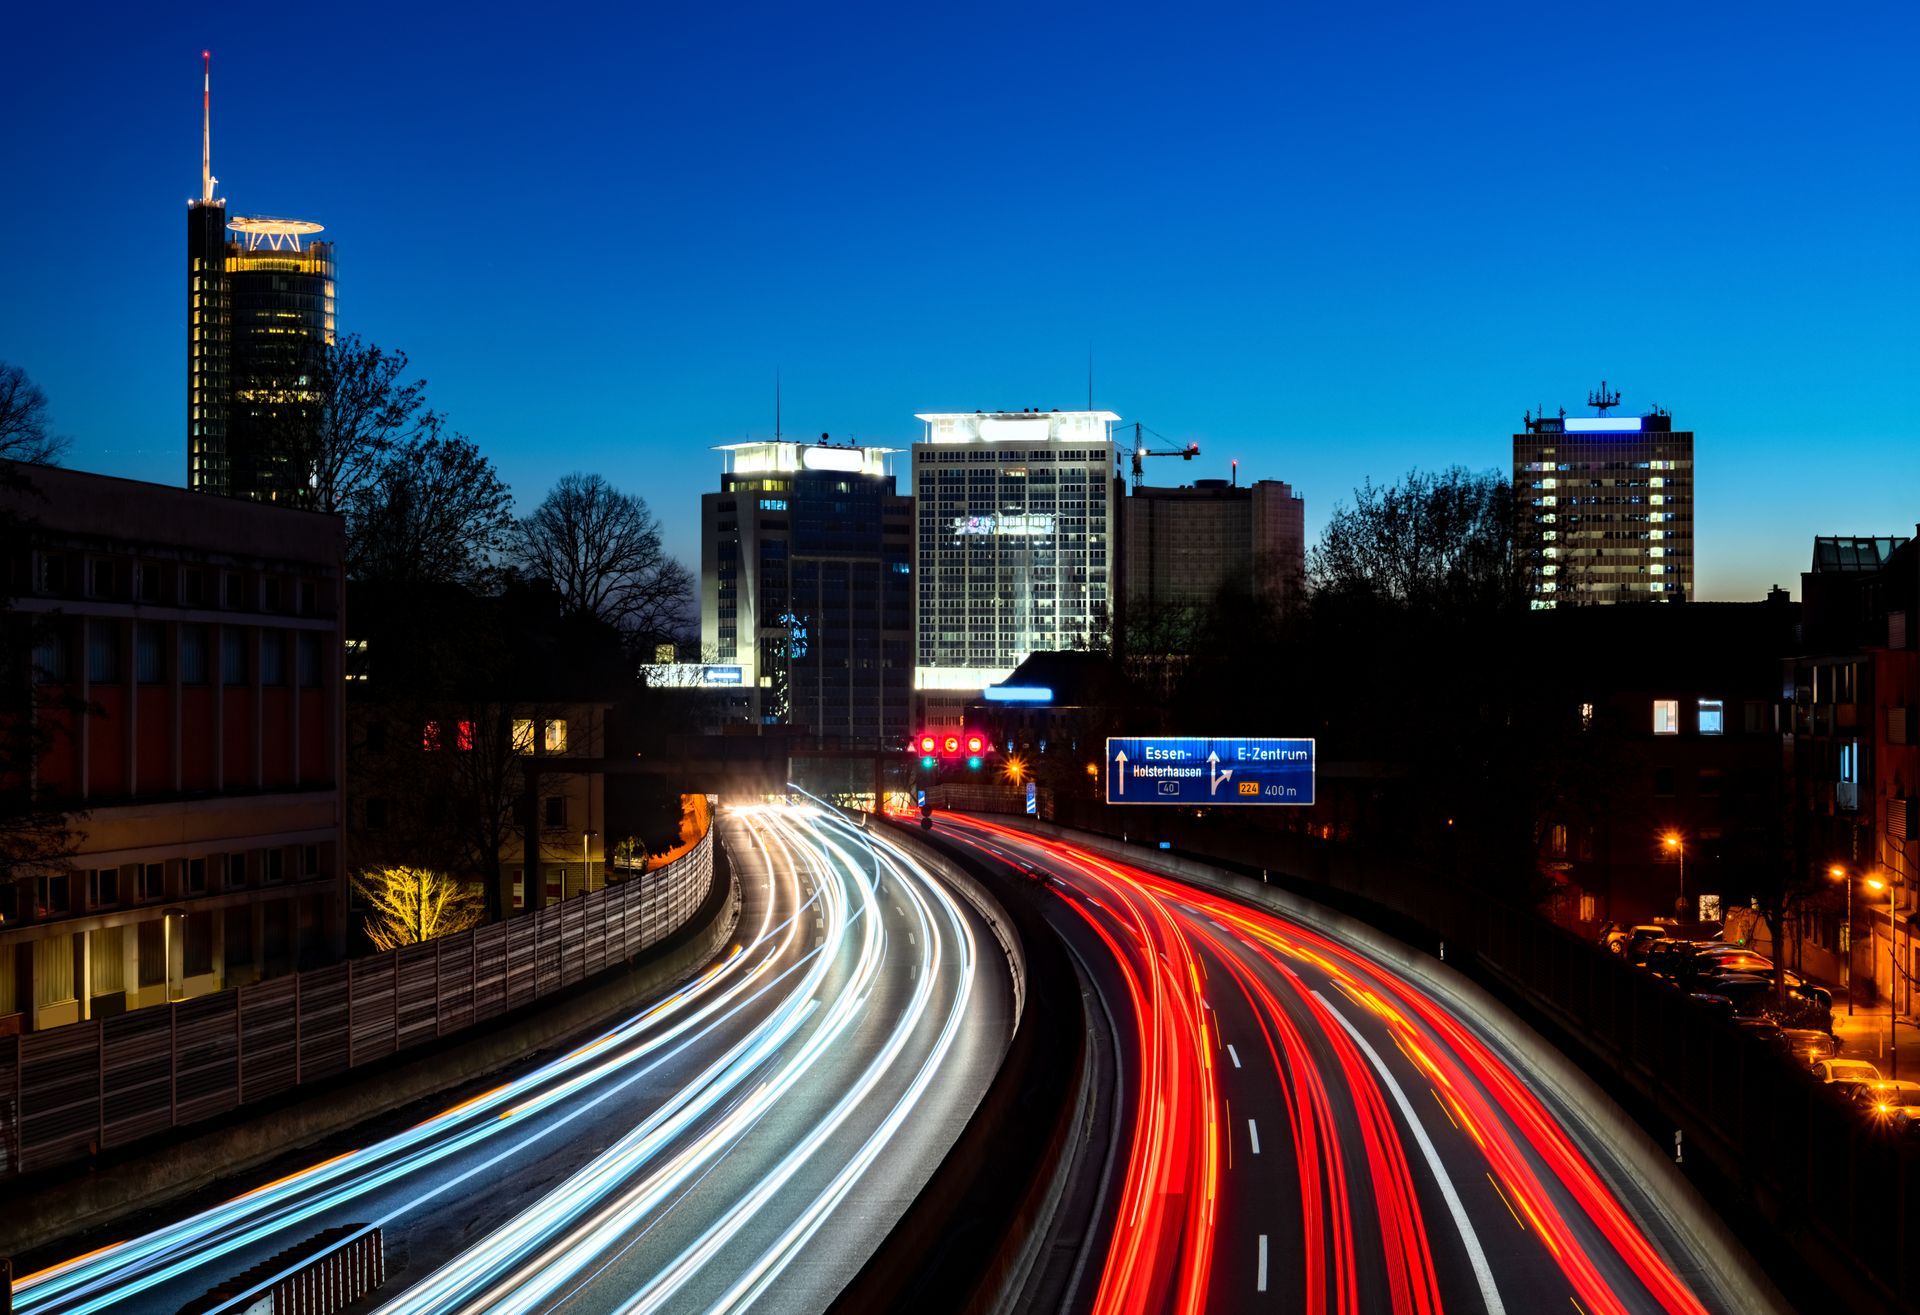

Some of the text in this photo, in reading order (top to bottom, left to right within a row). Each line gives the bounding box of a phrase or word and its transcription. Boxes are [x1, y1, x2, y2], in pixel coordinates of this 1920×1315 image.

[1146, 747, 1192, 760] Essen-
[1238, 747, 1307, 760] E-Zentrum
[1134, 765, 1202, 778] Holsterhausen
[1241, 784, 1257, 793] 224
[1265, 785, 1296, 796] 400 m
